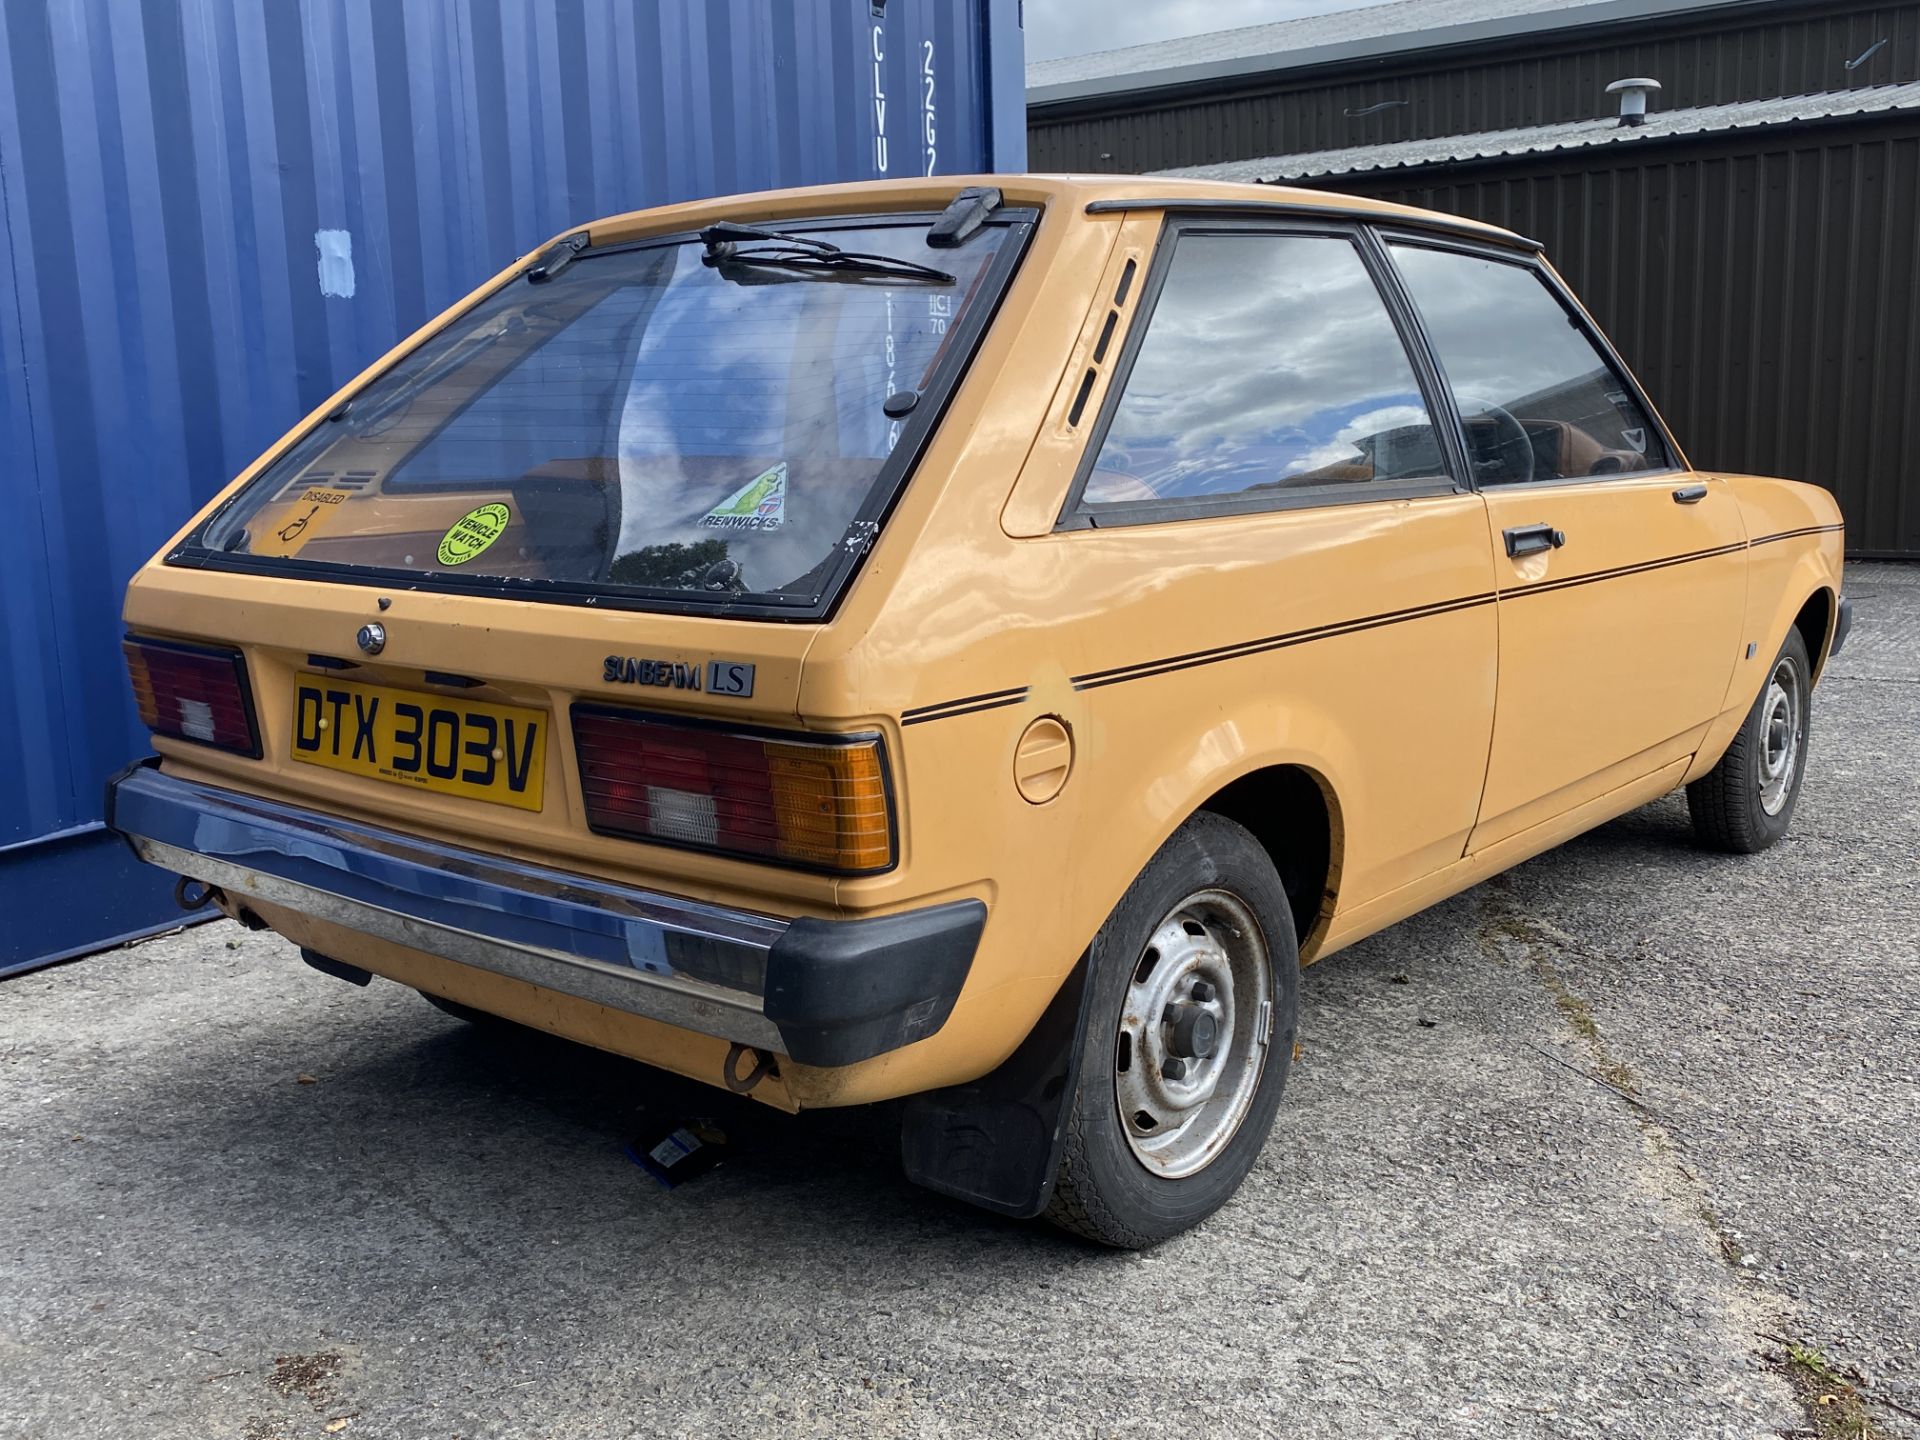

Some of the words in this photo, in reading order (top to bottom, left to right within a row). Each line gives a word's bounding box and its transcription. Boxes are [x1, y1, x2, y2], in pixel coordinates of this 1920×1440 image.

[873, 25, 888, 172] CLVU
[930, 318, 946, 334] 70
[301, 490, 345, 505] DISABLED
[458, 517, 499, 540] VEHICLE
[703, 515, 779, 529] RENWICKS
[450, 529, 487, 550] WATCH
[603, 655, 702, 691] SUNBEAM
[712, 663, 745, 693] LS
[296, 686, 380, 764] DTX
[392, 702, 538, 793] 303V
